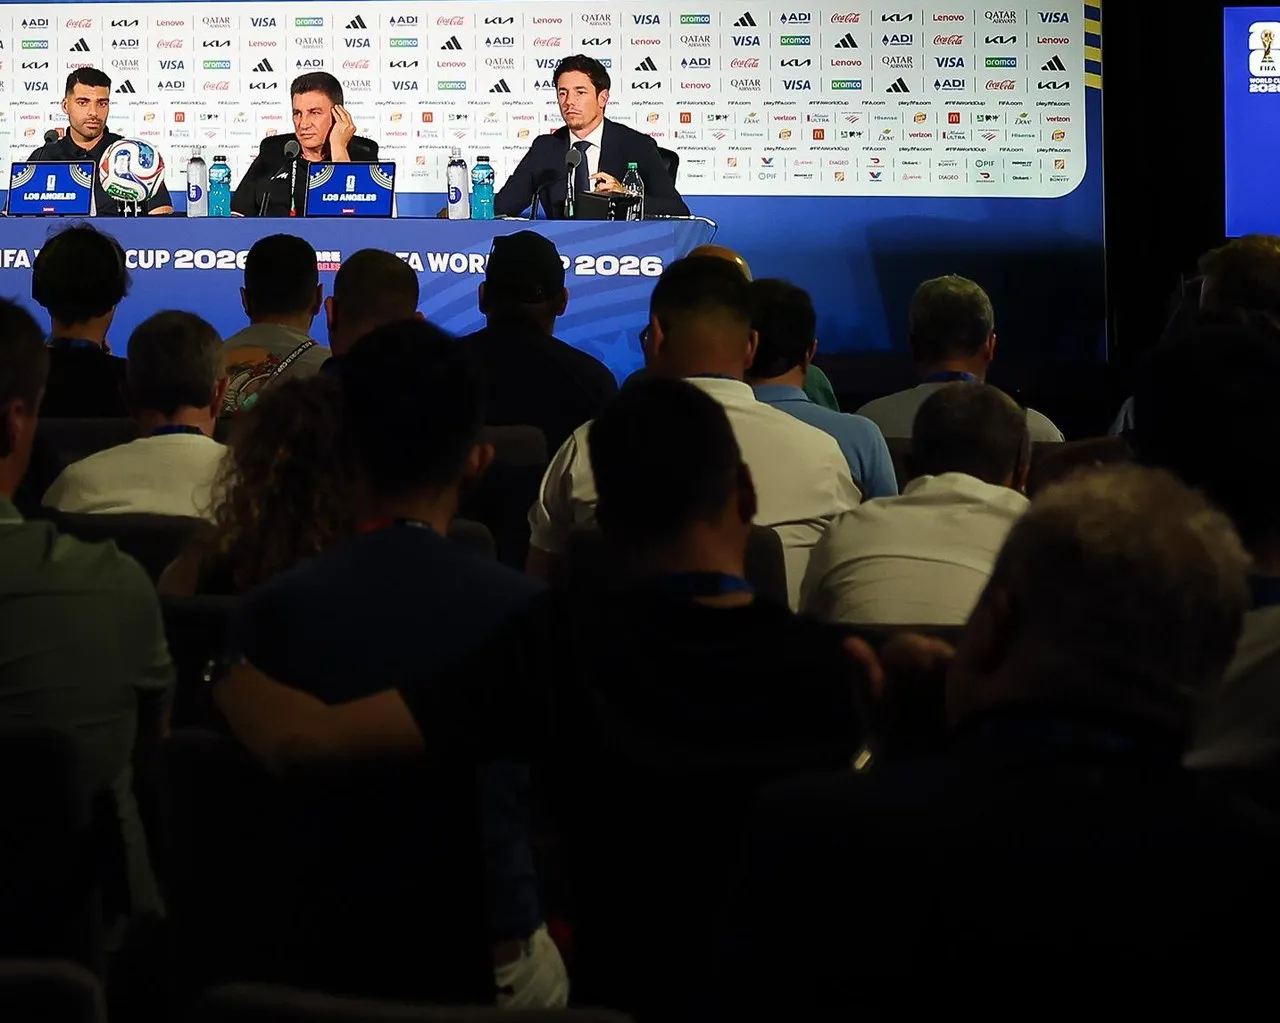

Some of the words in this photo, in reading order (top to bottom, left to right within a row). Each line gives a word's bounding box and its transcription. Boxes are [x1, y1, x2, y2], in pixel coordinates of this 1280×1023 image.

[681, 15, 710, 23] aramco
[789, 13, 811, 21] ADI
[882, 14, 913, 22] KIA
[984, 11, 1016, 19] QATAR
[1037, 12, 1069, 23] VISA
[29, 18, 49, 26] ADI
[296, 18, 323, 26] aramco
[295, 37, 323, 45] QATAR
[680, 35, 710, 43] QATAR
[732, 36, 760, 46] VISA
[781, 37, 810, 45] aramco
[891, 34, 913, 42] ADI
[985, 36, 1017, 44] KIA
[1037, 36, 1070, 44] Lenovo
[390, 39, 418, 47] aramco
[780, 59, 811, 67] KIA
[882, 56, 913, 64] QATAR
[934, 57, 964, 68] VISA
[986, 58, 1016, 66] aramco
[159, 60, 184, 70] VISA
[24, 81, 49, 91] VISA
[631, 81, 661, 89] KIA
[782, 80, 811, 90] VISA
[832, 81, 861, 89] aramco
[943, 79, 965, 87] ADI
[1038, 81, 1070, 89] KIA
[1015, 117, 1032, 125] Dove
[125, 250, 170, 269] CUP
[575, 256, 663, 277] 2026
